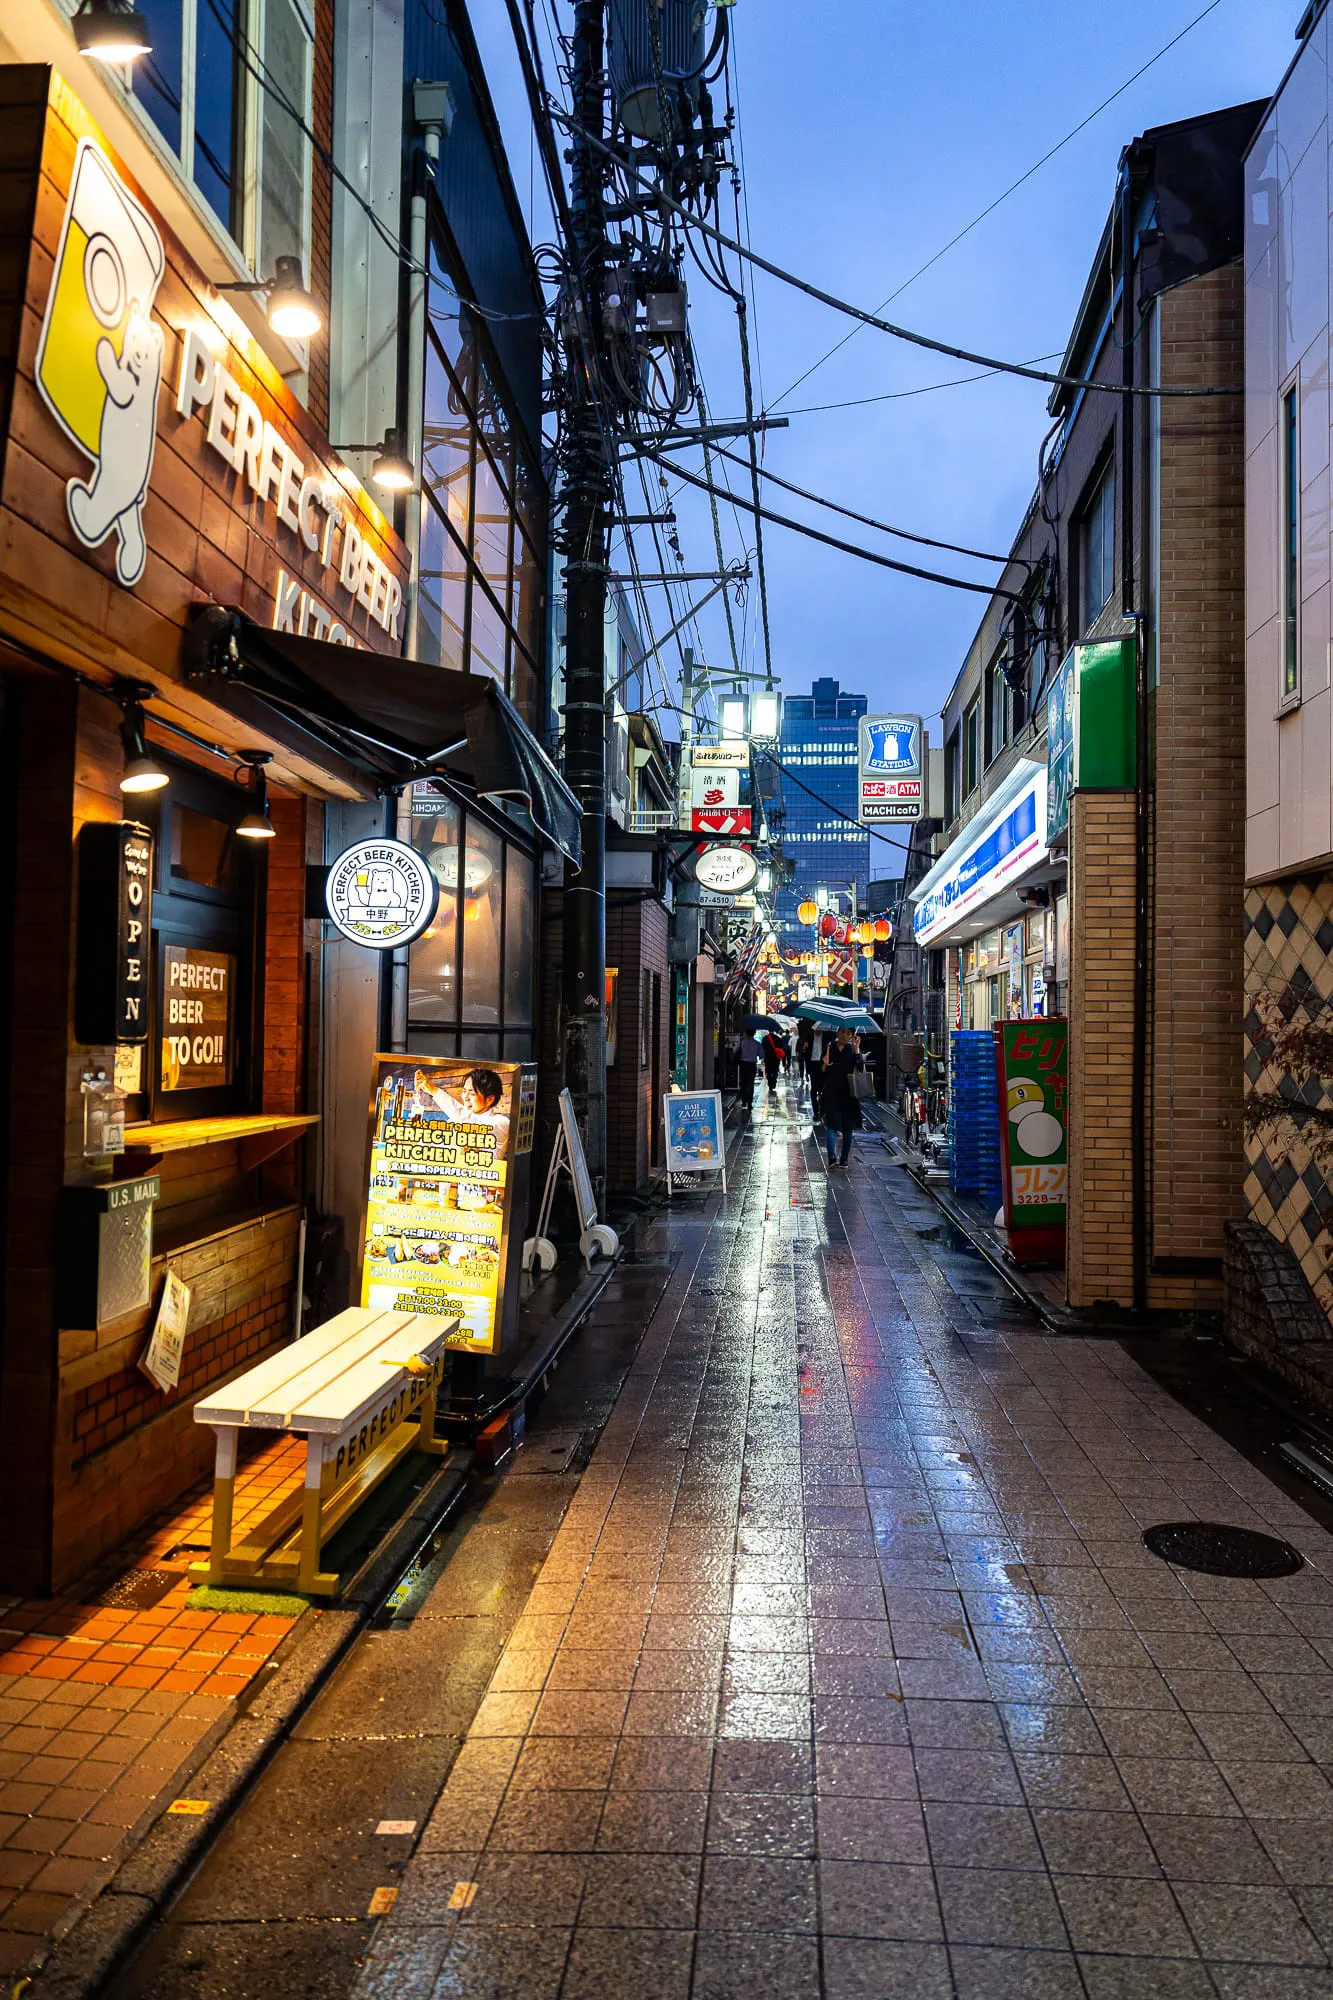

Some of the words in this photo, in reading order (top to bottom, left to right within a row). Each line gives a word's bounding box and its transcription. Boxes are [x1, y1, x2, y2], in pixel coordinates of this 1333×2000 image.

[176, 328, 341, 569] PERFECT
[339, 521, 402, 641] BEER
[871, 723, 912, 735] LAWSON
[695, 752, 746, 761] ふれあいロード
[870, 759, 911, 769] STATION
[863, 783, 885, 795] たばこ
[898, 784, 920, 795] ATM
[864, 806, 897, 815] MACHI
[896, 805, 918, 815] café
[335, 854, 363, 903] PERFECT
[364, 849, 395, 862] BEER
[394, 855, 421, 904] KITCHEN
[366, 908, 389, 920] 中野
[126, 881, 143, 1021] OPEN
[170, 961, 226, 992] PERFECT
[169, 998, 204, 1025] BEER
[169, 1036, 190, 1065] TO
[192, 1035, 224, 1064] GO!!
[1017, 1088, 1025, 1099] 9
[678, 1109, 707, 1119] ZAZIE
[684, 1103, 700, 1111] BAR
[384, 1125, 453, 1145] PERFECT
[456, 1132, 496, 1149] BEER
[385, 1143, 456, 1163] KITCHEN
[465, 1150, 493, 1167] 中野
[111, 1188, 131, 1209] U.S.
[134, 1182, 158, 1202] MAIL
[335, 1388, 406, 1480] PERFECT
